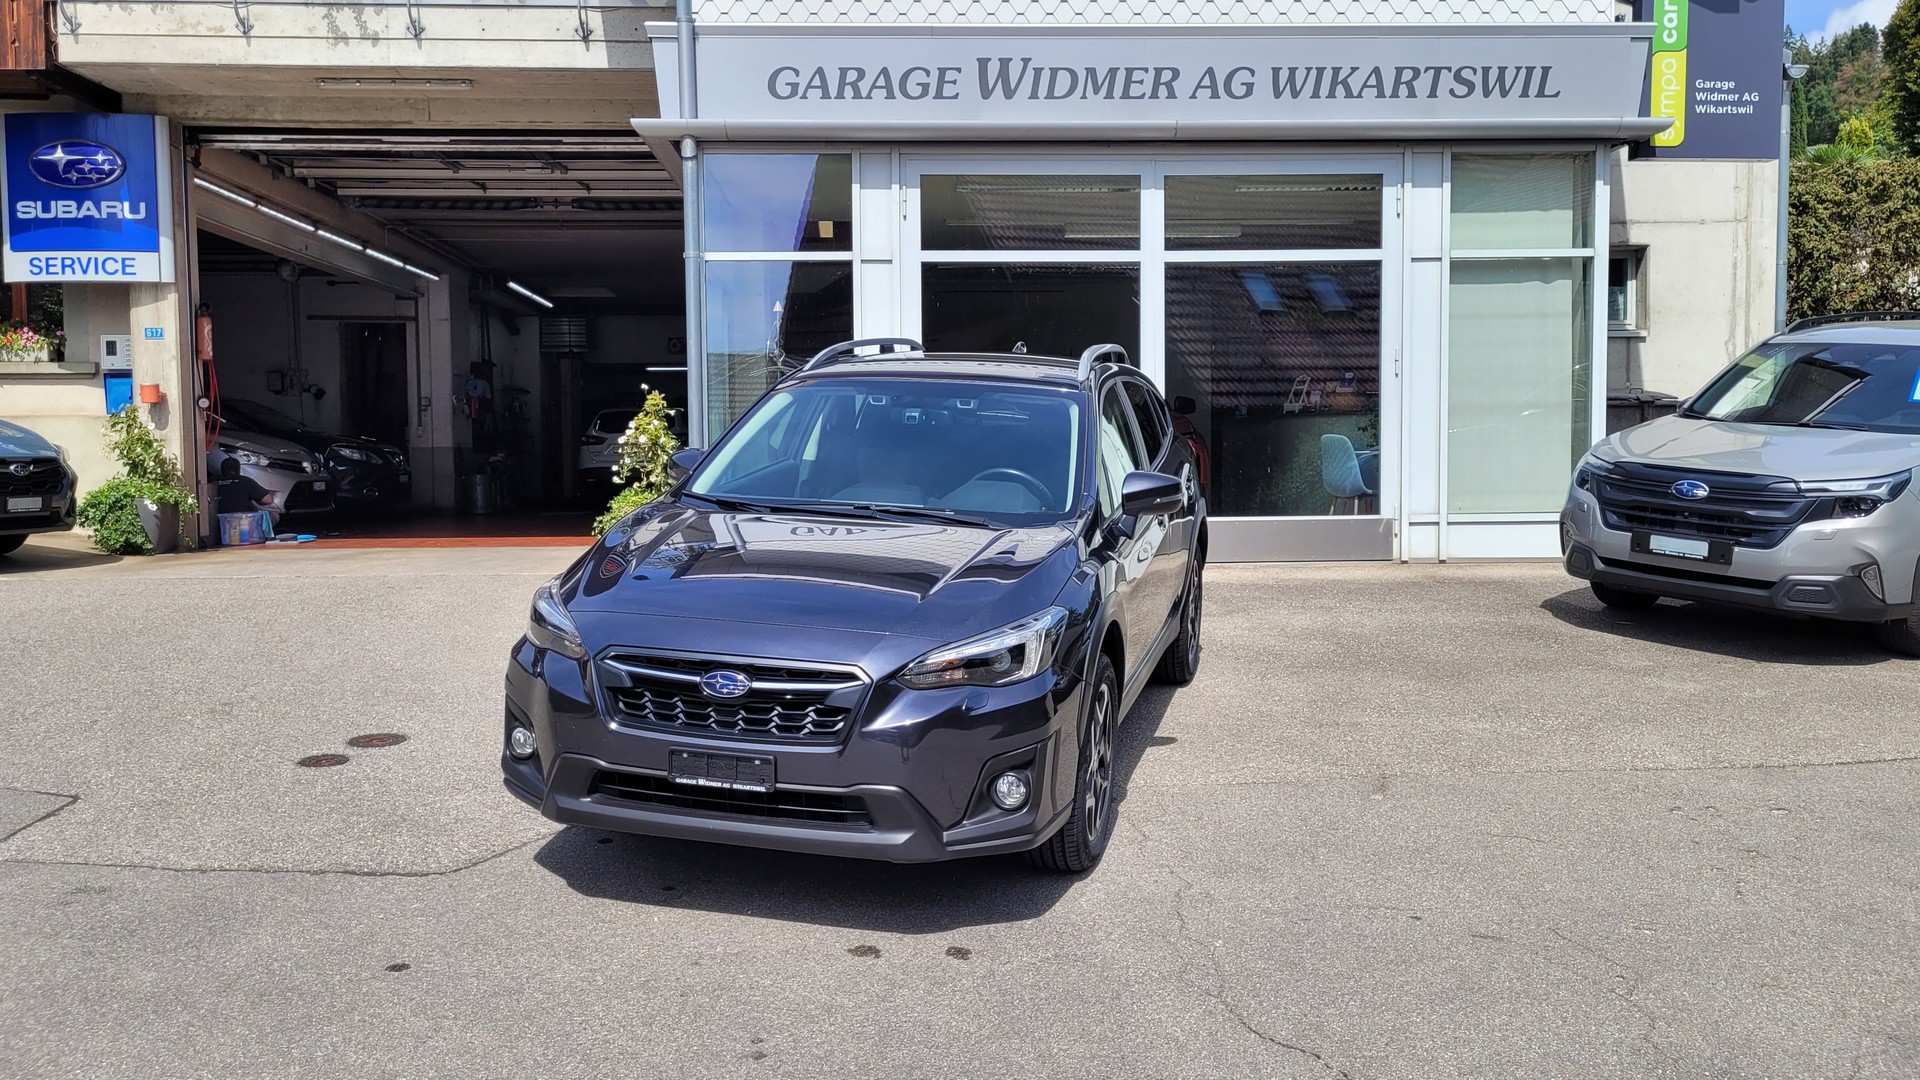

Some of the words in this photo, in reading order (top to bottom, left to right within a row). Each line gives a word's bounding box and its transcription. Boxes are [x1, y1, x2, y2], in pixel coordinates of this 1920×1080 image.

[1662, 0, 1679, 44] car
[767, 66, 962, 100] GARAGE
[975, 57, 1181, 100] WIDMER
[1188, 66, 1256, 100] AG
[1270, 65, 1561, 100] WIKARTSWIL
[1695, 79, 1736, 91] Garage
[1695, 92, 1740, 102] Widmer
[1742, 92, 1760, 102] AG
[1695, 104, 1754, 114] Wikartswil
[16, 200, 146, 220] SUBARU
[29, 256, 137, 276] SERVICE
[146, 327, 162, 338] 617
[676, 777, 697, 785] GARAGE
